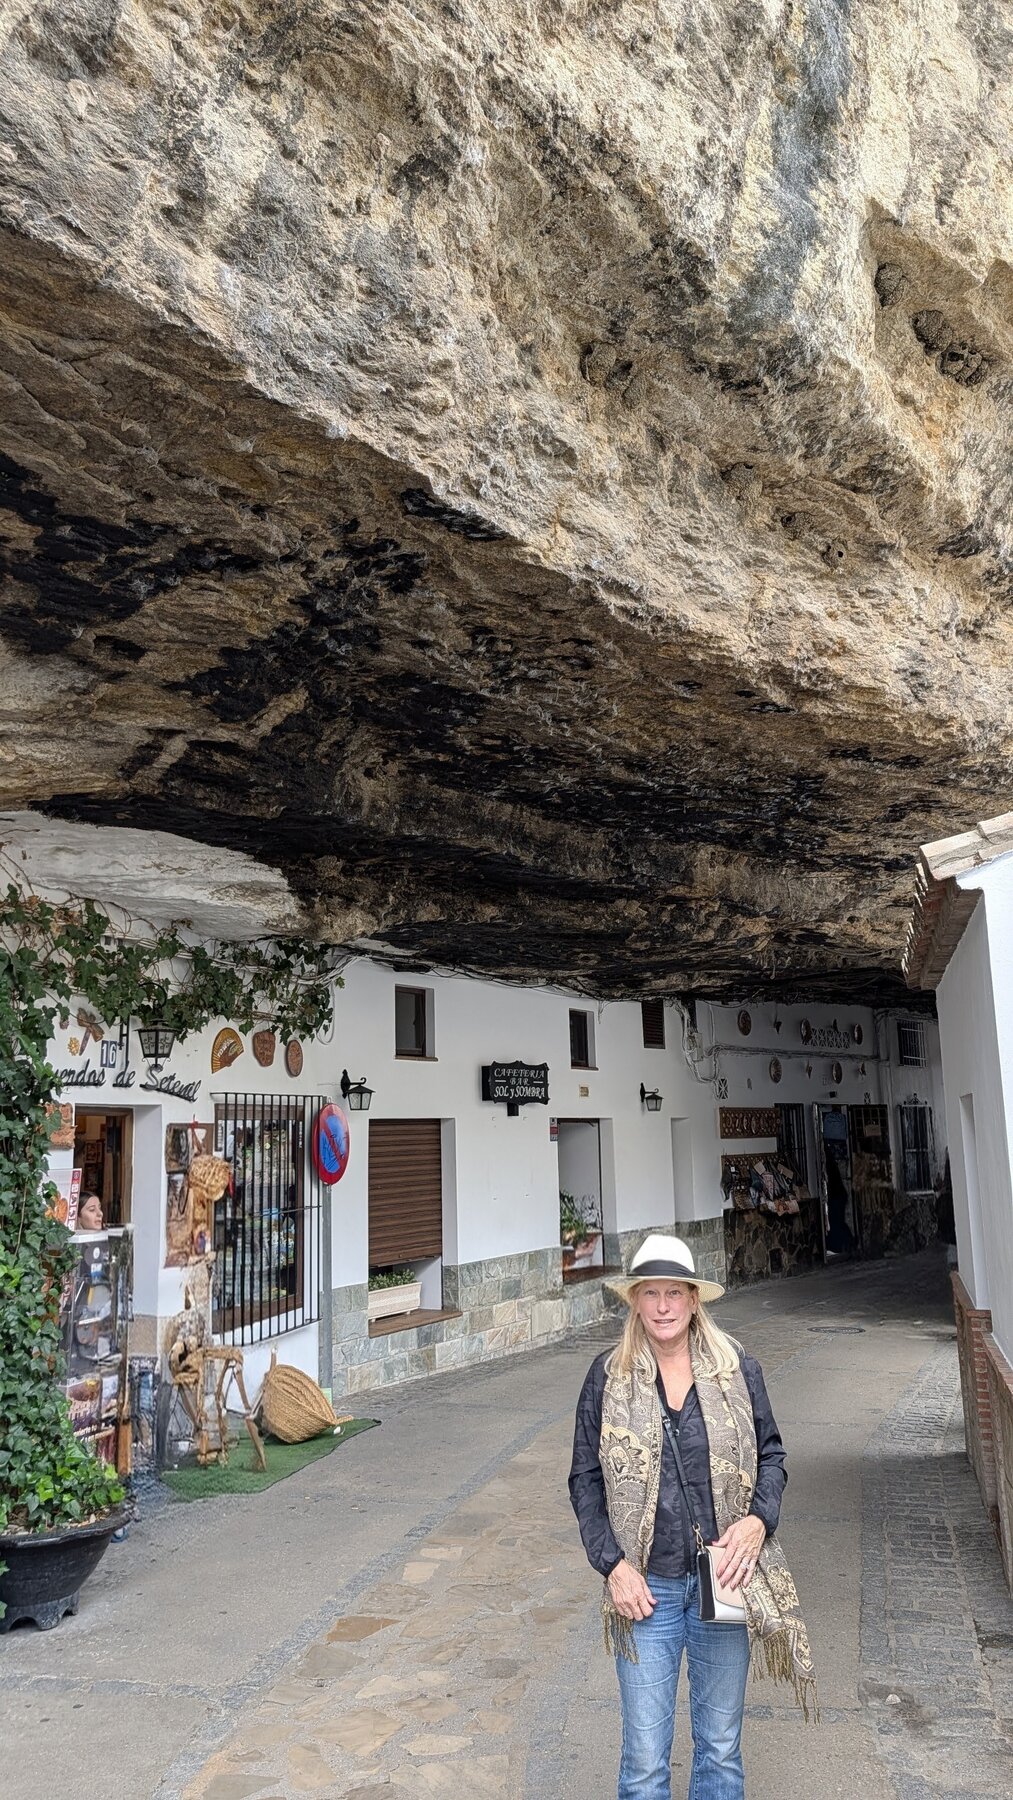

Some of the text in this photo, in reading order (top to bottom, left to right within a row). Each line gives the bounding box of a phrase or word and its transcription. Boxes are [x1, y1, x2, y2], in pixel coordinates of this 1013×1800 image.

[102, 1044, 116, 1065] 16
[494, 1068, 545, 1078] CAFETERIA
[113, 1060, 136, 1087] de
[141, 1064, 202, 1102] Setenil
[510, 1078, 530, 1086] BAR
[494, 1086, 545, 1099] SOL y SOMBRA
